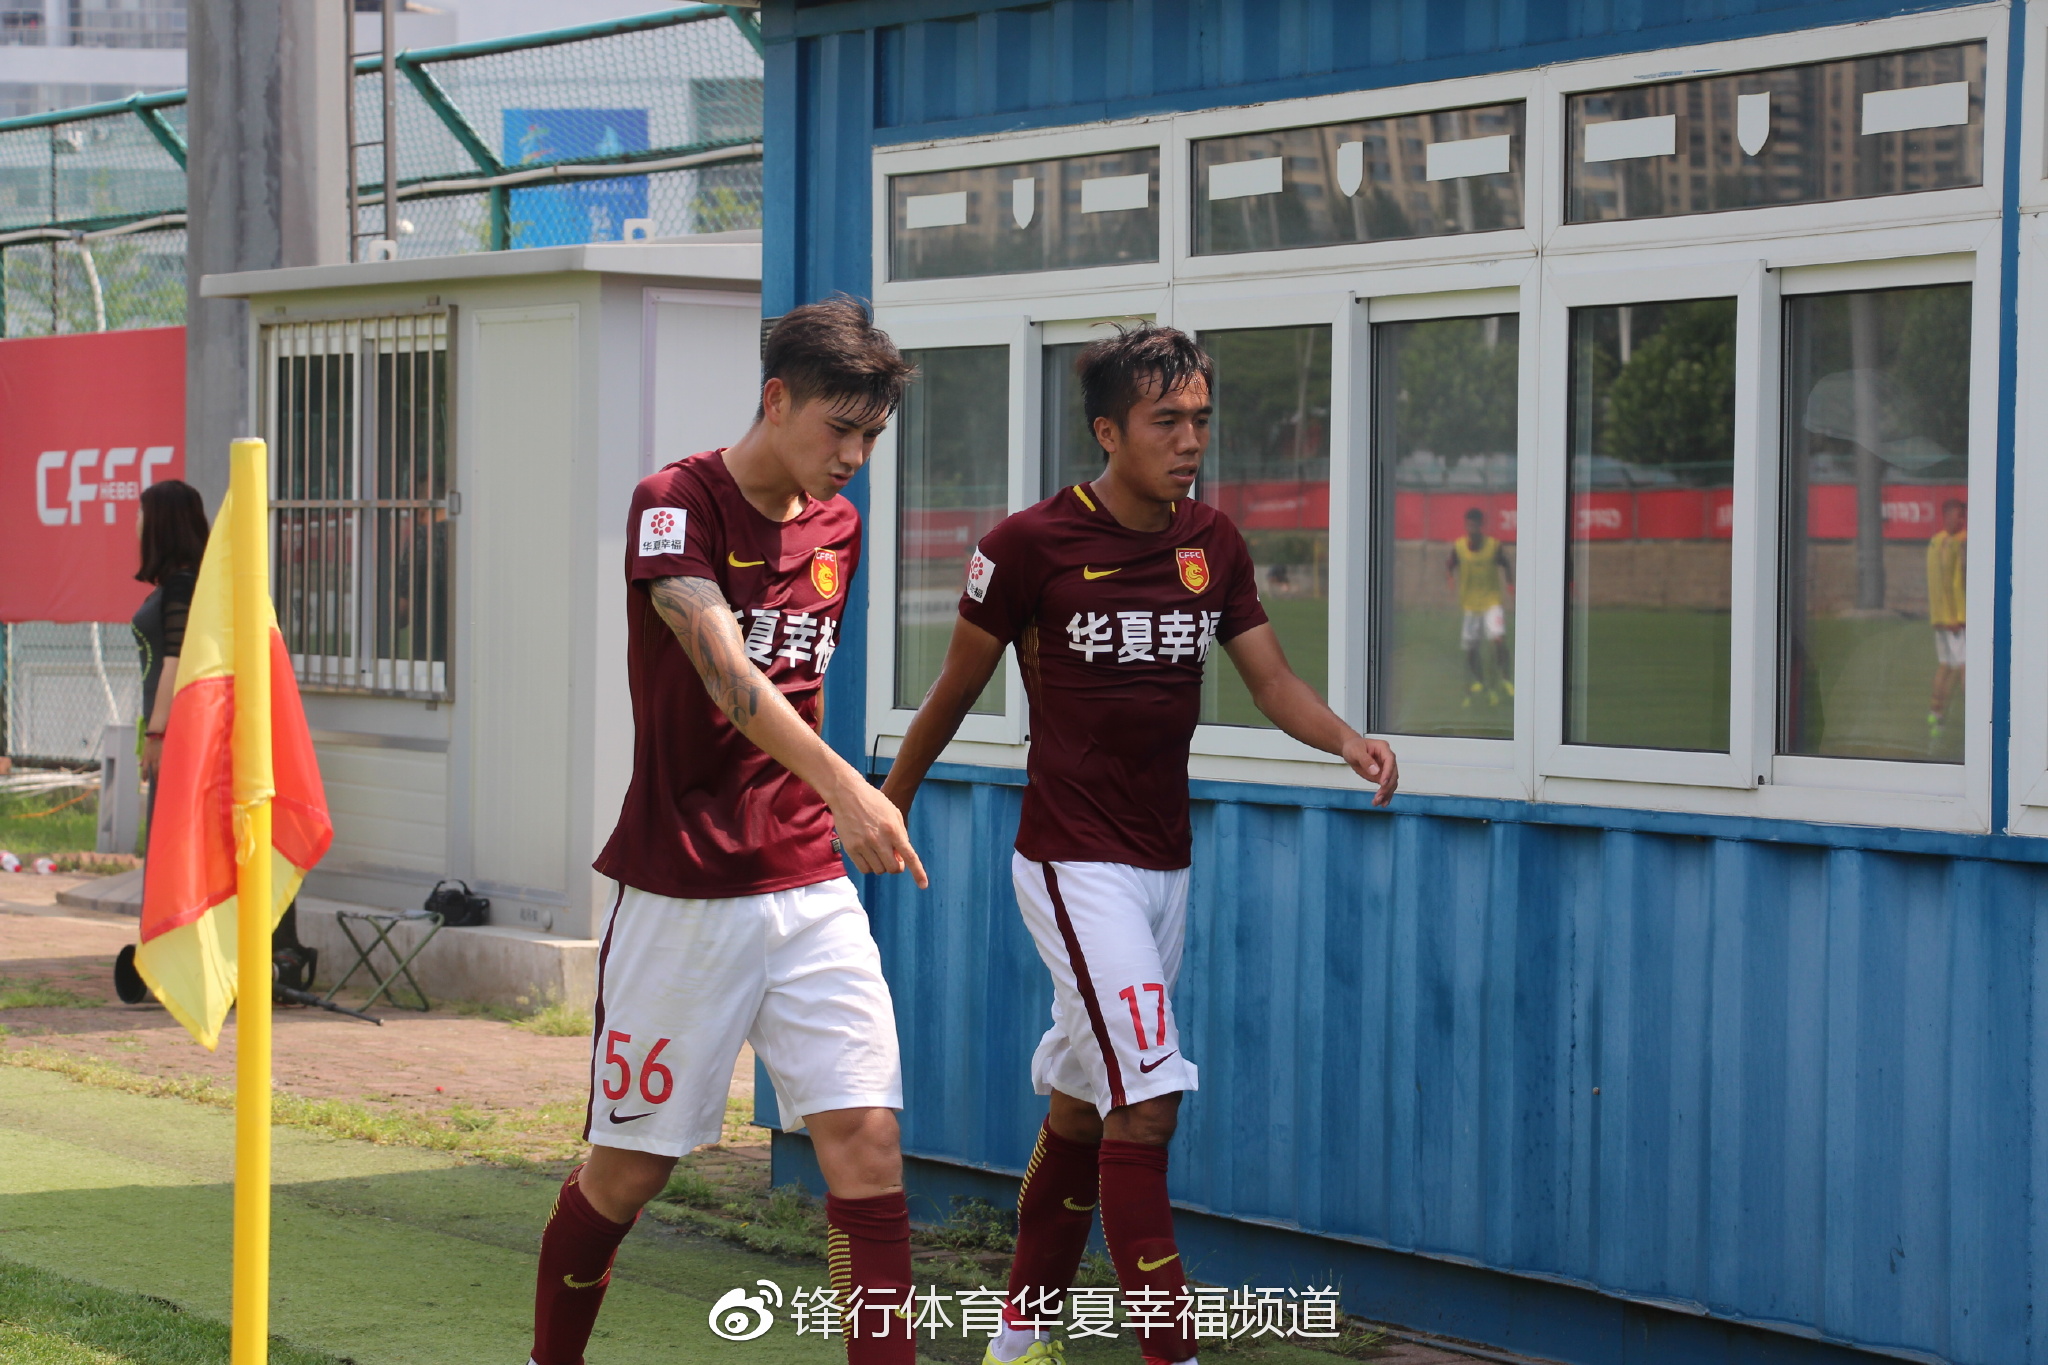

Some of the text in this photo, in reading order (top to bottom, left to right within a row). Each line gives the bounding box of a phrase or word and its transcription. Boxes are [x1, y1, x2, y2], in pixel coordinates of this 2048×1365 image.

[642, 539, 682, 552] 华夏幸福
[1178, 551, 1201, 559] CFFC
[729, 604, 837, 674] 夏幸福
[1119, 983, 1165, 1050] 17
[603, 1030, 673, 1104] 56
